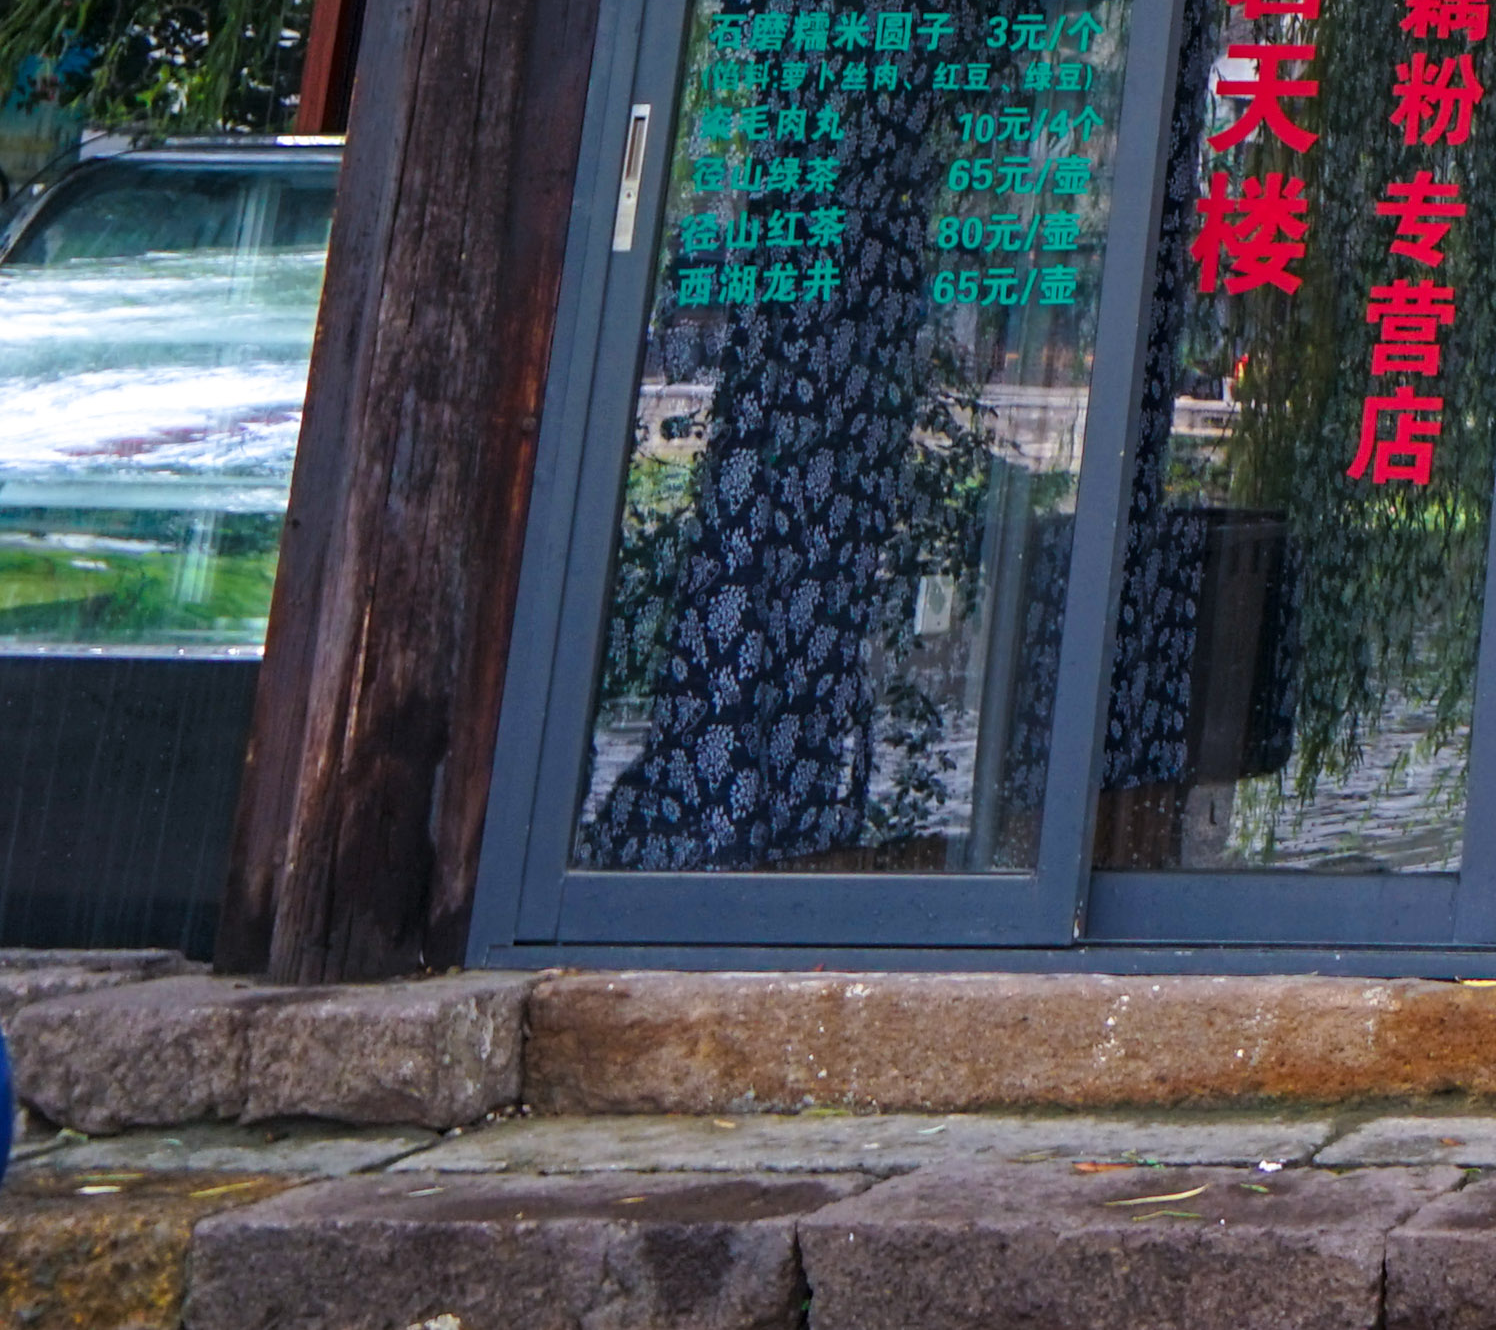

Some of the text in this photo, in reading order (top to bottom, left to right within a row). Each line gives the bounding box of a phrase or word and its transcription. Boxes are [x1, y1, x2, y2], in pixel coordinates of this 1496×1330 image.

[709, 12, 1105, 53] 石磨糯米圆子 3元/个
[959, 106, 1105, 144] 10元/4个
[692, 155, 1093, 196] 径山绿茶 65元/壶
[681, 206, 1081, 254] 径山红茶 80元/壶
[679, 262, 1079, 308] 西湖龙井 65元/壶
